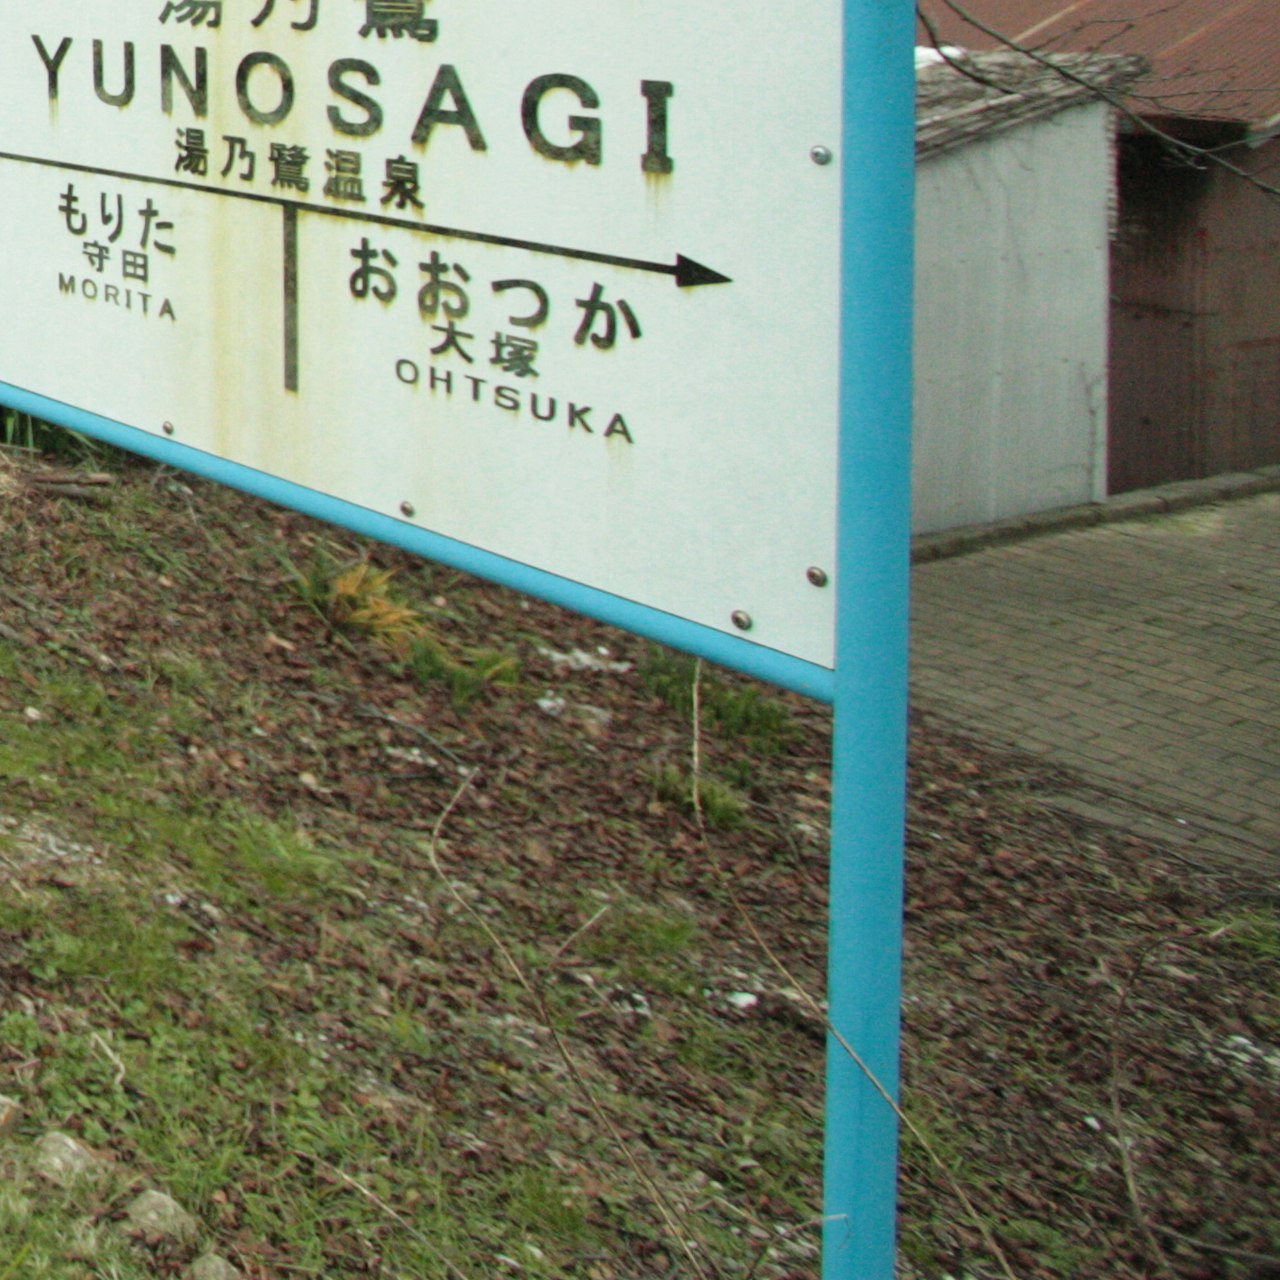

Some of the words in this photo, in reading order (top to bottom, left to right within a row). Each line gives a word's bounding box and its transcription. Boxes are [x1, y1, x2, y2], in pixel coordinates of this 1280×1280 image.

[31, 35, 674, 174] YUNOSAGI
[173, 127, 426, 210] 湯乃鷺温泉
[58, 183, 177, 256] もりた
[57, 272, 178, 320] MORITA
[82, 241, 150, 283] 守田
[348, 237, 643, 349] おおつか
[428, 320, 540, 378] 大塚
[395, 357, 634, 444] OHTSUKA
